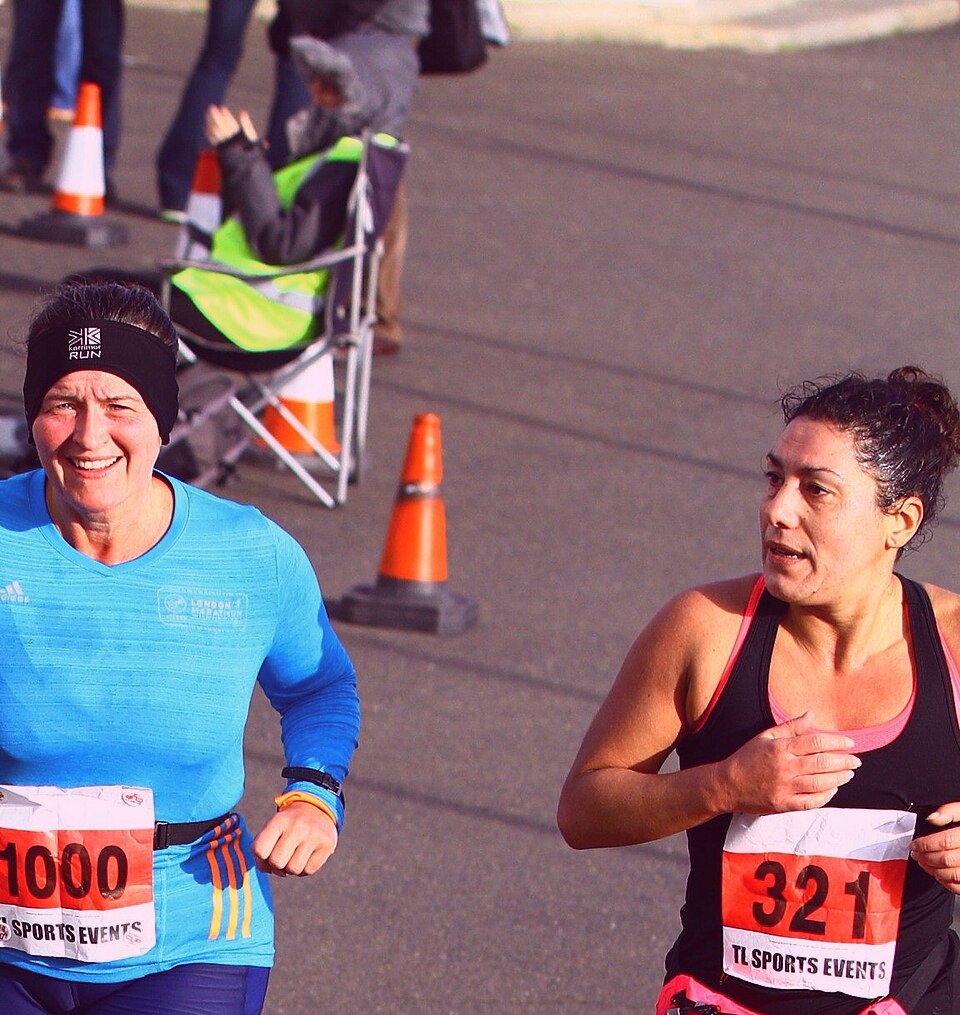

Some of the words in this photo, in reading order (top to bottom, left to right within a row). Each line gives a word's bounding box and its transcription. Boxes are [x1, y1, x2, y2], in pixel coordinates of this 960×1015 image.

[69, 351, 101, 360] RUN
[190, 598, 231, 609] LONDON
[0, 842, 128, 900] 1000
[752, 860, 871, 940] 321
[12, 919, 76, 943] SPORTS
[732, 944, 749, 966] TL
[751, 948, 818, 974] SPORTS
[823, 957, 886, 980] EVENTS
